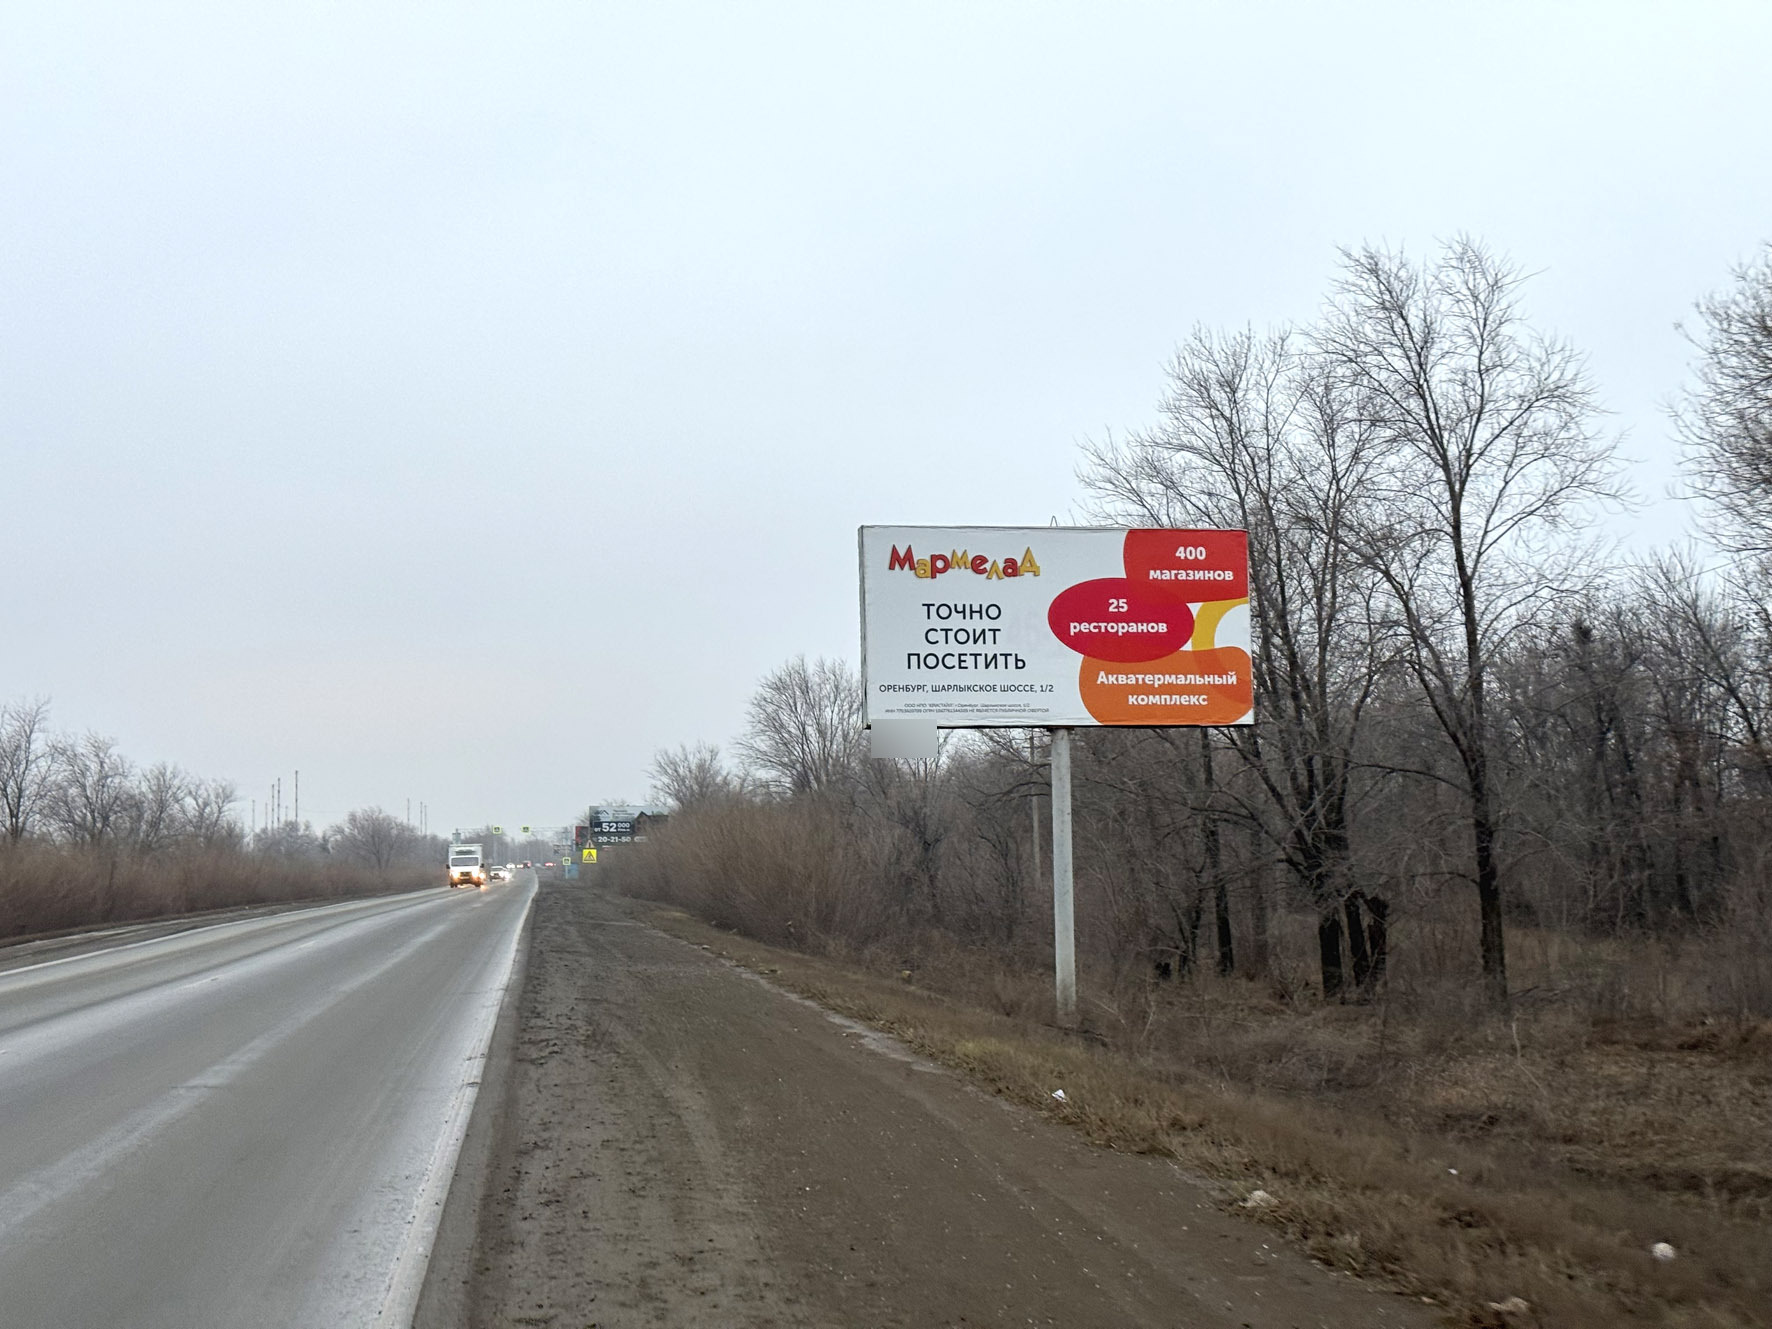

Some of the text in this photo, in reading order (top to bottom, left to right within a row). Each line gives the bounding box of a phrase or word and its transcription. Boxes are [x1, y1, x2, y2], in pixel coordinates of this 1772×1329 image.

[1175, 546, 1206, 560] 400
[1148, 569, 1234, 581] магазинов
[922, 603, 1002, 620] ТОЧНО
[1108, 599, 1129, 612] 25
[1069, 621, 1168, 636] ресторанов
[924, 628, 1001, 645] СТОИТ
[907, 652, 1026, 670] ПОСЕТИТЬ
[1096, 671, 1237, 687] Акватермальный
[879, 683, 1054, 694] ОРЕНБУРГ, ШАРЛЫКСКОЕ ШОССЕ, 1/2
[1128, 694, 1208, 706] комплекс
[602, 823, 617, 832] 52
